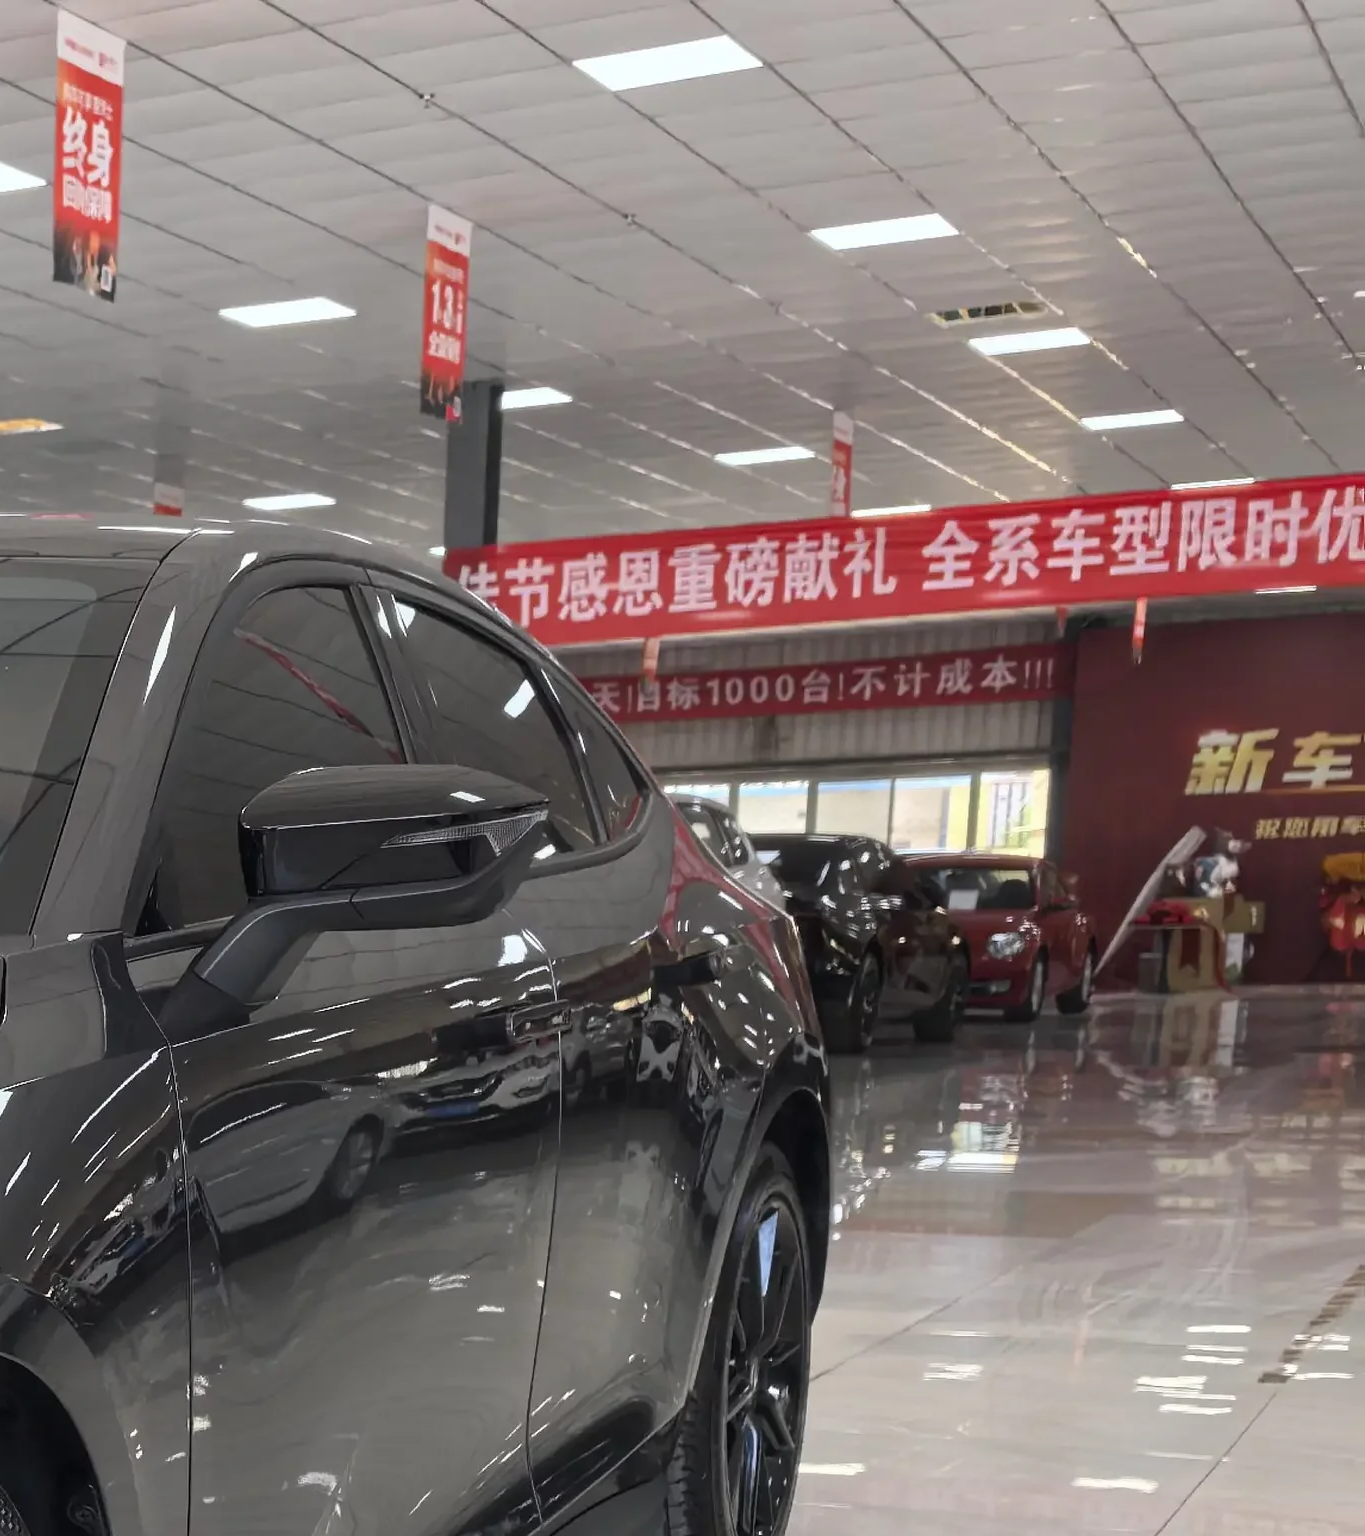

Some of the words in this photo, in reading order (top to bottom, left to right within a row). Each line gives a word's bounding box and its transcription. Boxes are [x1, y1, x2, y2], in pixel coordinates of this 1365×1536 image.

[62, 105, 114, 188] 终身
[457, 526, 899, 630] 佳节感恩重磅献礼
[921, 484, 1365, 594] 全系车型限时优
[1184, 728, 1365, 796] 新车
